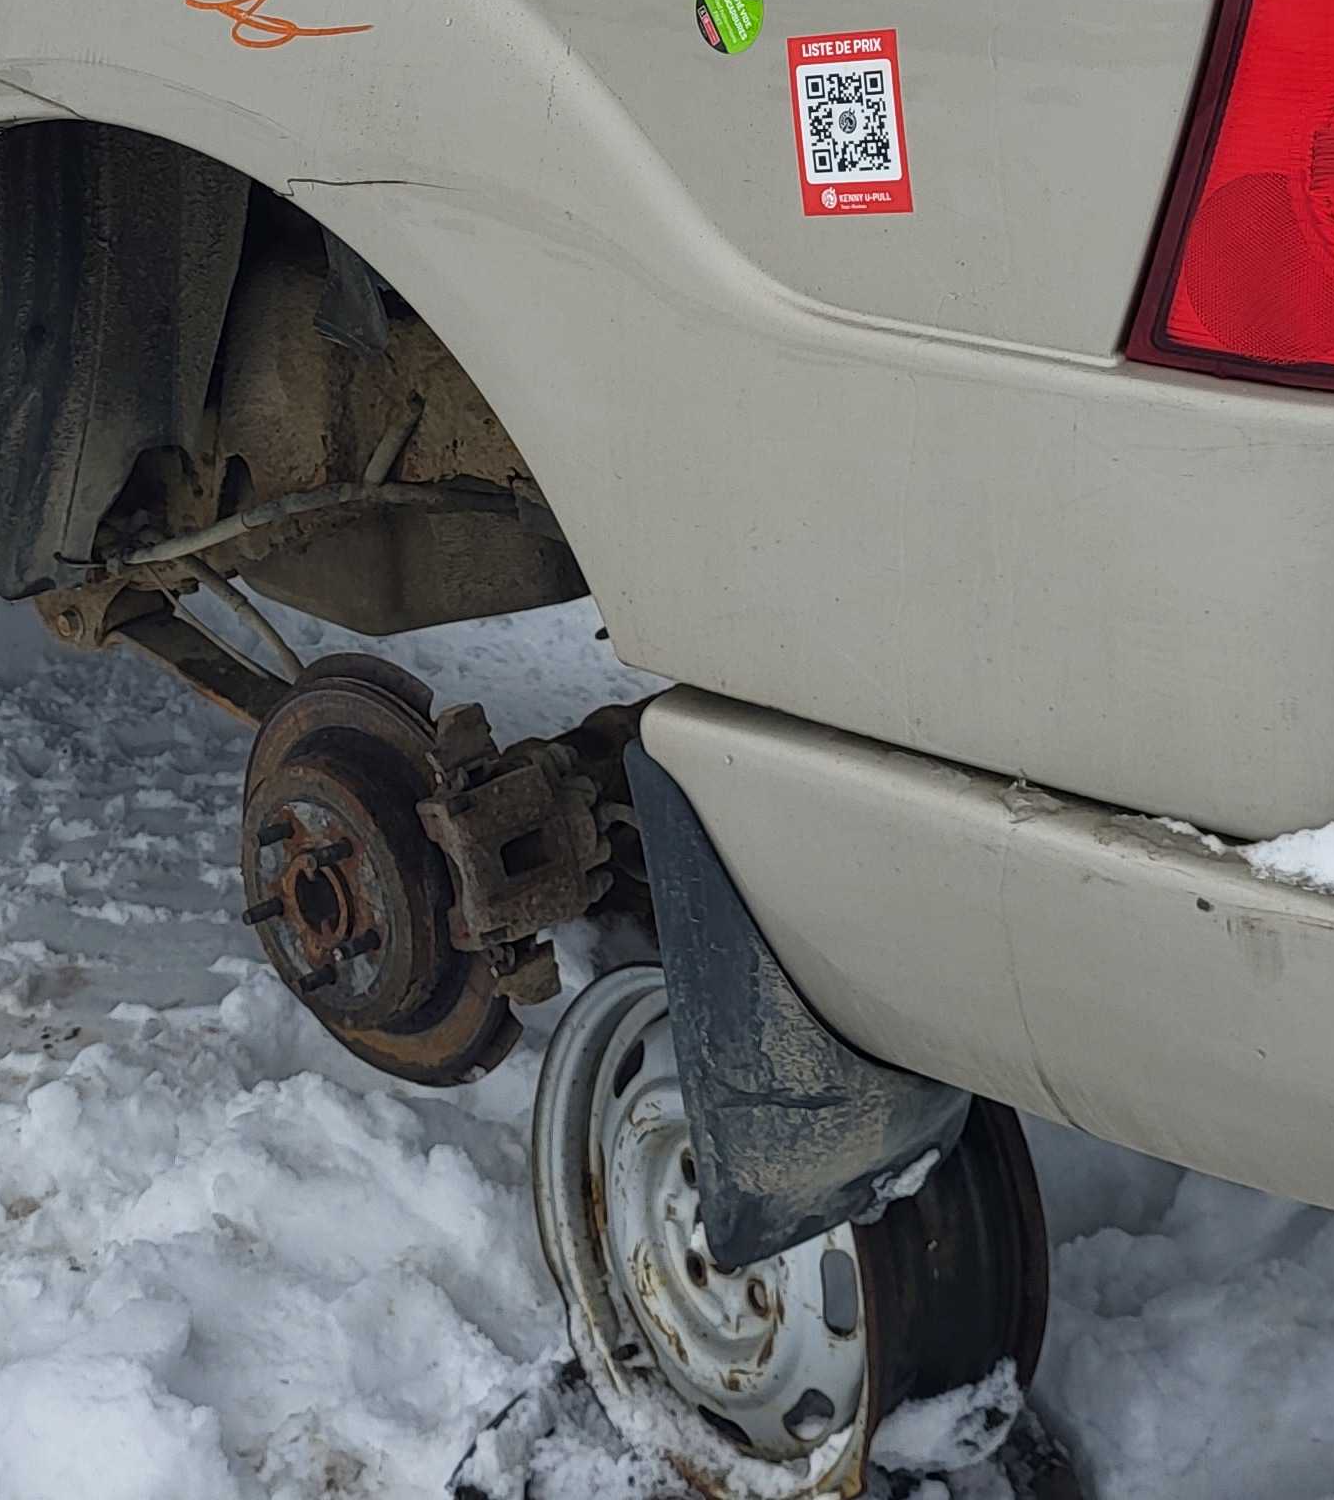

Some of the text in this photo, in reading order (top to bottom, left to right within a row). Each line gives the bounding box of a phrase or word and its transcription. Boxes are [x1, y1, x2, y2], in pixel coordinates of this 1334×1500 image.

[801, 37, 882, 58] LISTE DE PRIX
